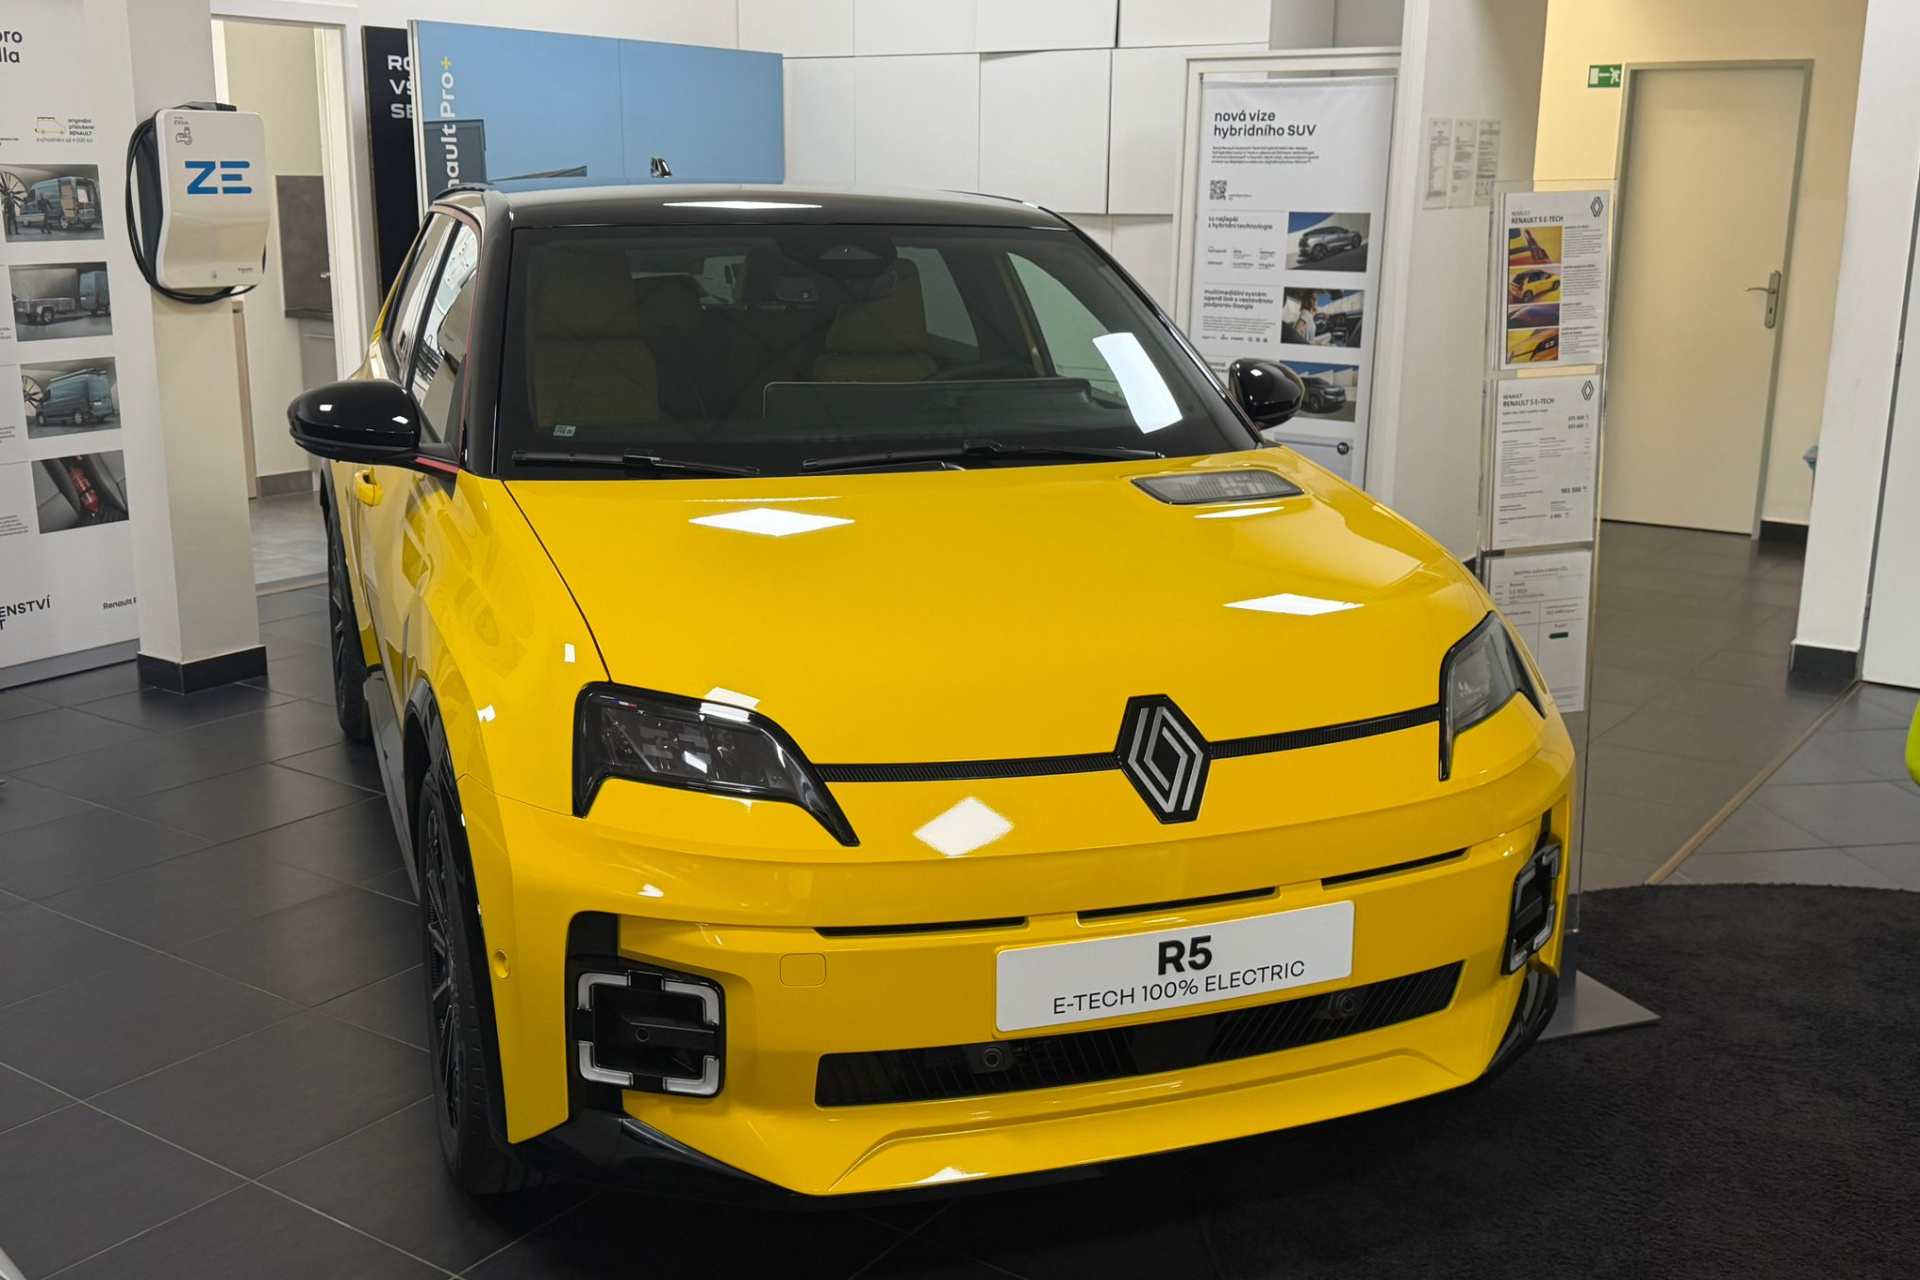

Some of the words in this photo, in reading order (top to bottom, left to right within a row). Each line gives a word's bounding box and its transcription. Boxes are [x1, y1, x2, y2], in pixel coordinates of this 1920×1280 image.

[0, 31, 22, 44] ro
[0, 46, 20, 63] la
[440, 56, 456, 118] Pro+
[1215, 110, 1246, 122] nová
[1249, 110, 1275, 122] vize
[1214, 125, 1285, 139] hybridního
[1288, 125, 1316, 136] SUV
[185, 160, 252, 194] ZE
[1216, 216, 1238, 224] nejlepší
[1237, 223, 1272, 231] technologie
[1503, 399, 1528, 407] RENAULT
[103, 598, 132, 609] Renault
[1157, 935, 1213, 976] R5
[1053, 986, 1134, 1015] E-TECH
[1141, 979, 1199, 1002] 100%
[1205, 960, 1305, 992] ELECTRIC
